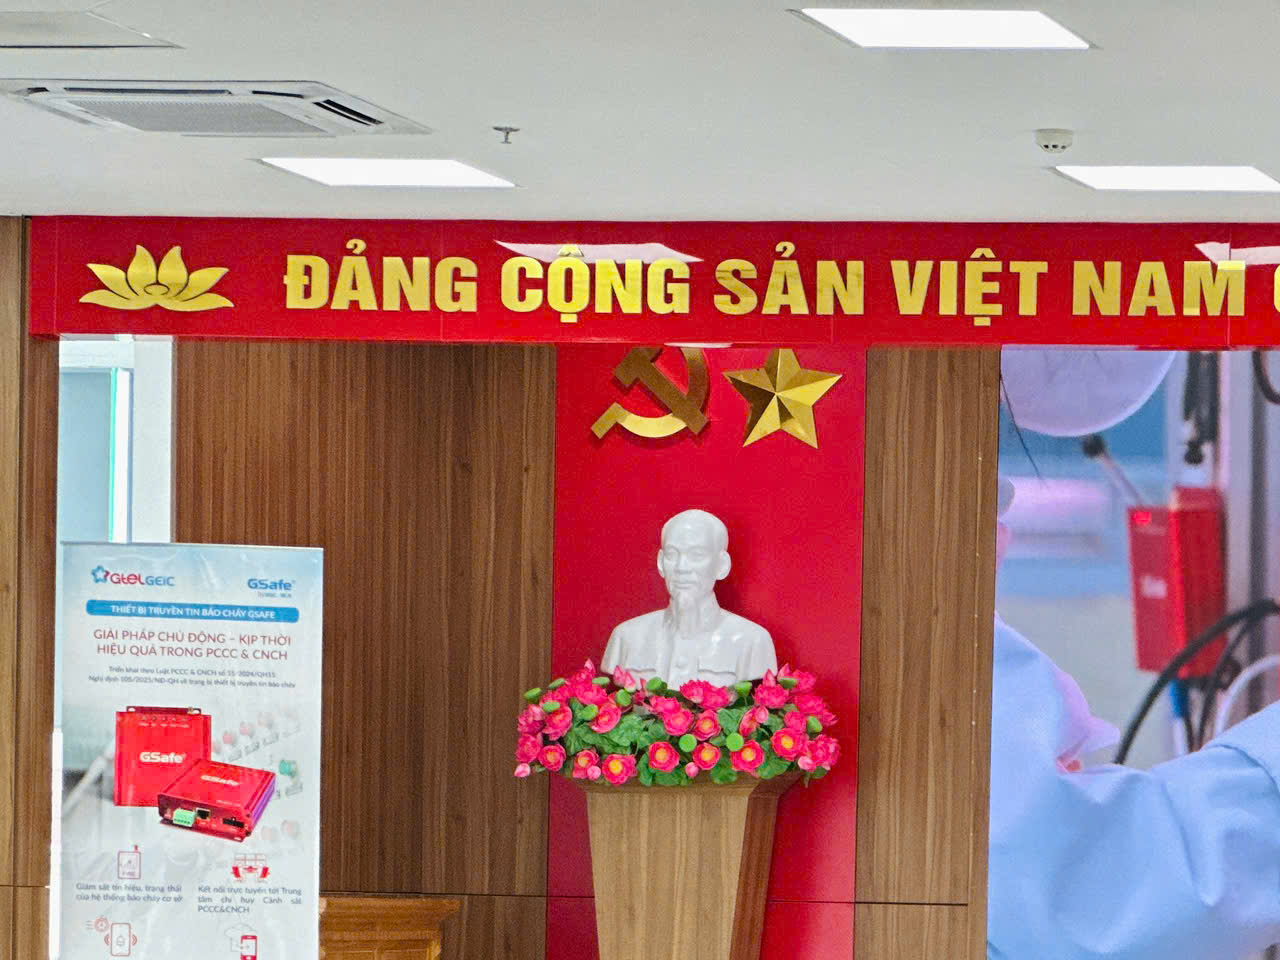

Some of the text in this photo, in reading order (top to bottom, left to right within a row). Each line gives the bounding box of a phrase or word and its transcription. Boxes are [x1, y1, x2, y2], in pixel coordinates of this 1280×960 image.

[284, 239, 477, 311] ĐẢNG
[501, 244, 690, 322] CỘNG
[714, 241, 864, 315] SẢN
[891, 247, 1048, 326] VIỆT
[1073, 260, 1245, 316] NAM
[111, 603, 136, 614] THIẾT
[149, 605, 183, 616] TRUYỀN
[185, 608, 200, 617] TIN
[202, 606, 221, 617] BÁO
[222, 607, 247, 618] CHÁY
[248, 610, 276, 619] GSAFE
[94, 626, 118, 640] GIẢI
[122, 628, 155, 641] PHÁP
[158, 629, 184, 642] CHỦ
[188, 630, 226, 645] ĐỘNG
[239, 634, 258, 646] KỊP
[260, 632, 291, 646] THỜI
[97, 642, 287, 661] HIỆU QUẢ TRONG PCCC & CNCH
